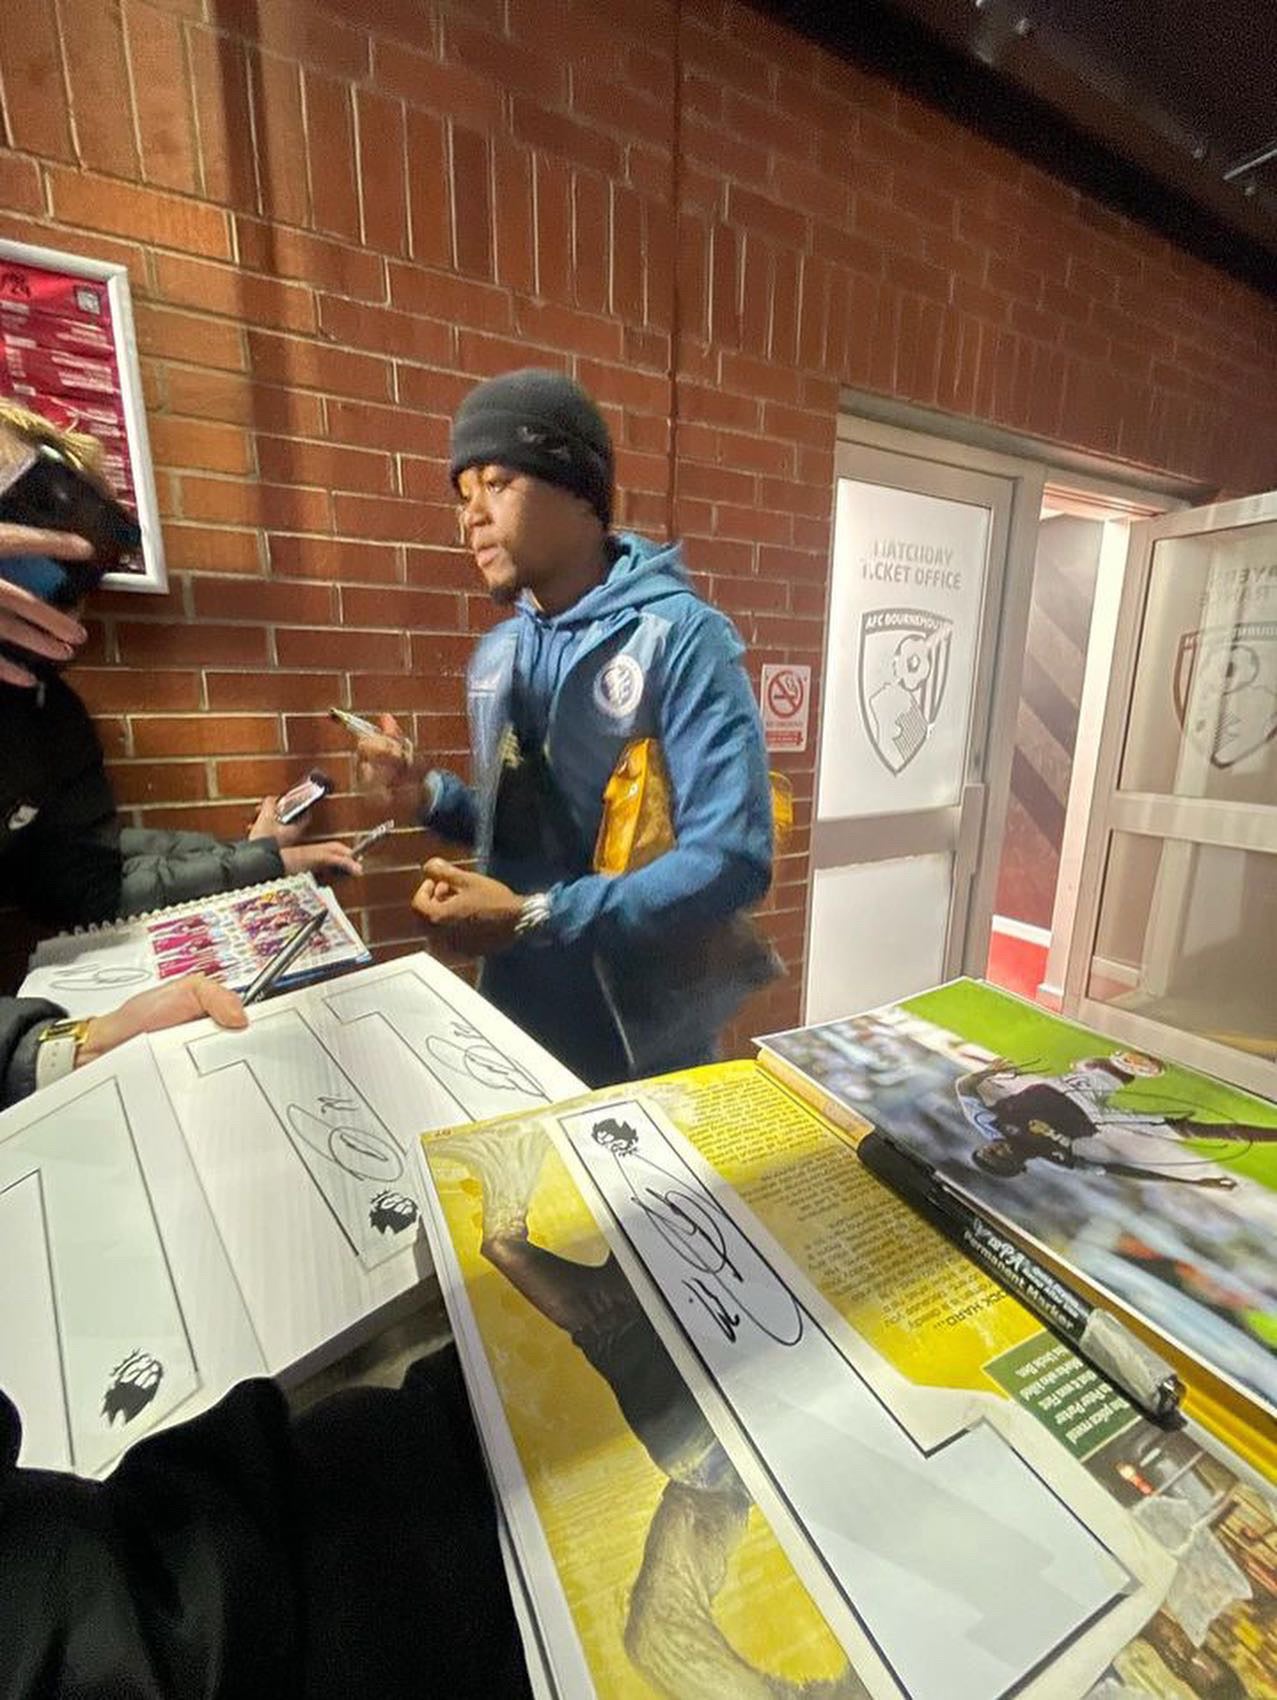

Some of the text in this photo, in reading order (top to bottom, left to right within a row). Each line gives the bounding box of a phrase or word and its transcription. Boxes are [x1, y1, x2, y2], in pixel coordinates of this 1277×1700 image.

[915, 567, 962, 590] OFFICE
[961, 1229, 1075, 1331] Permanent Marker
